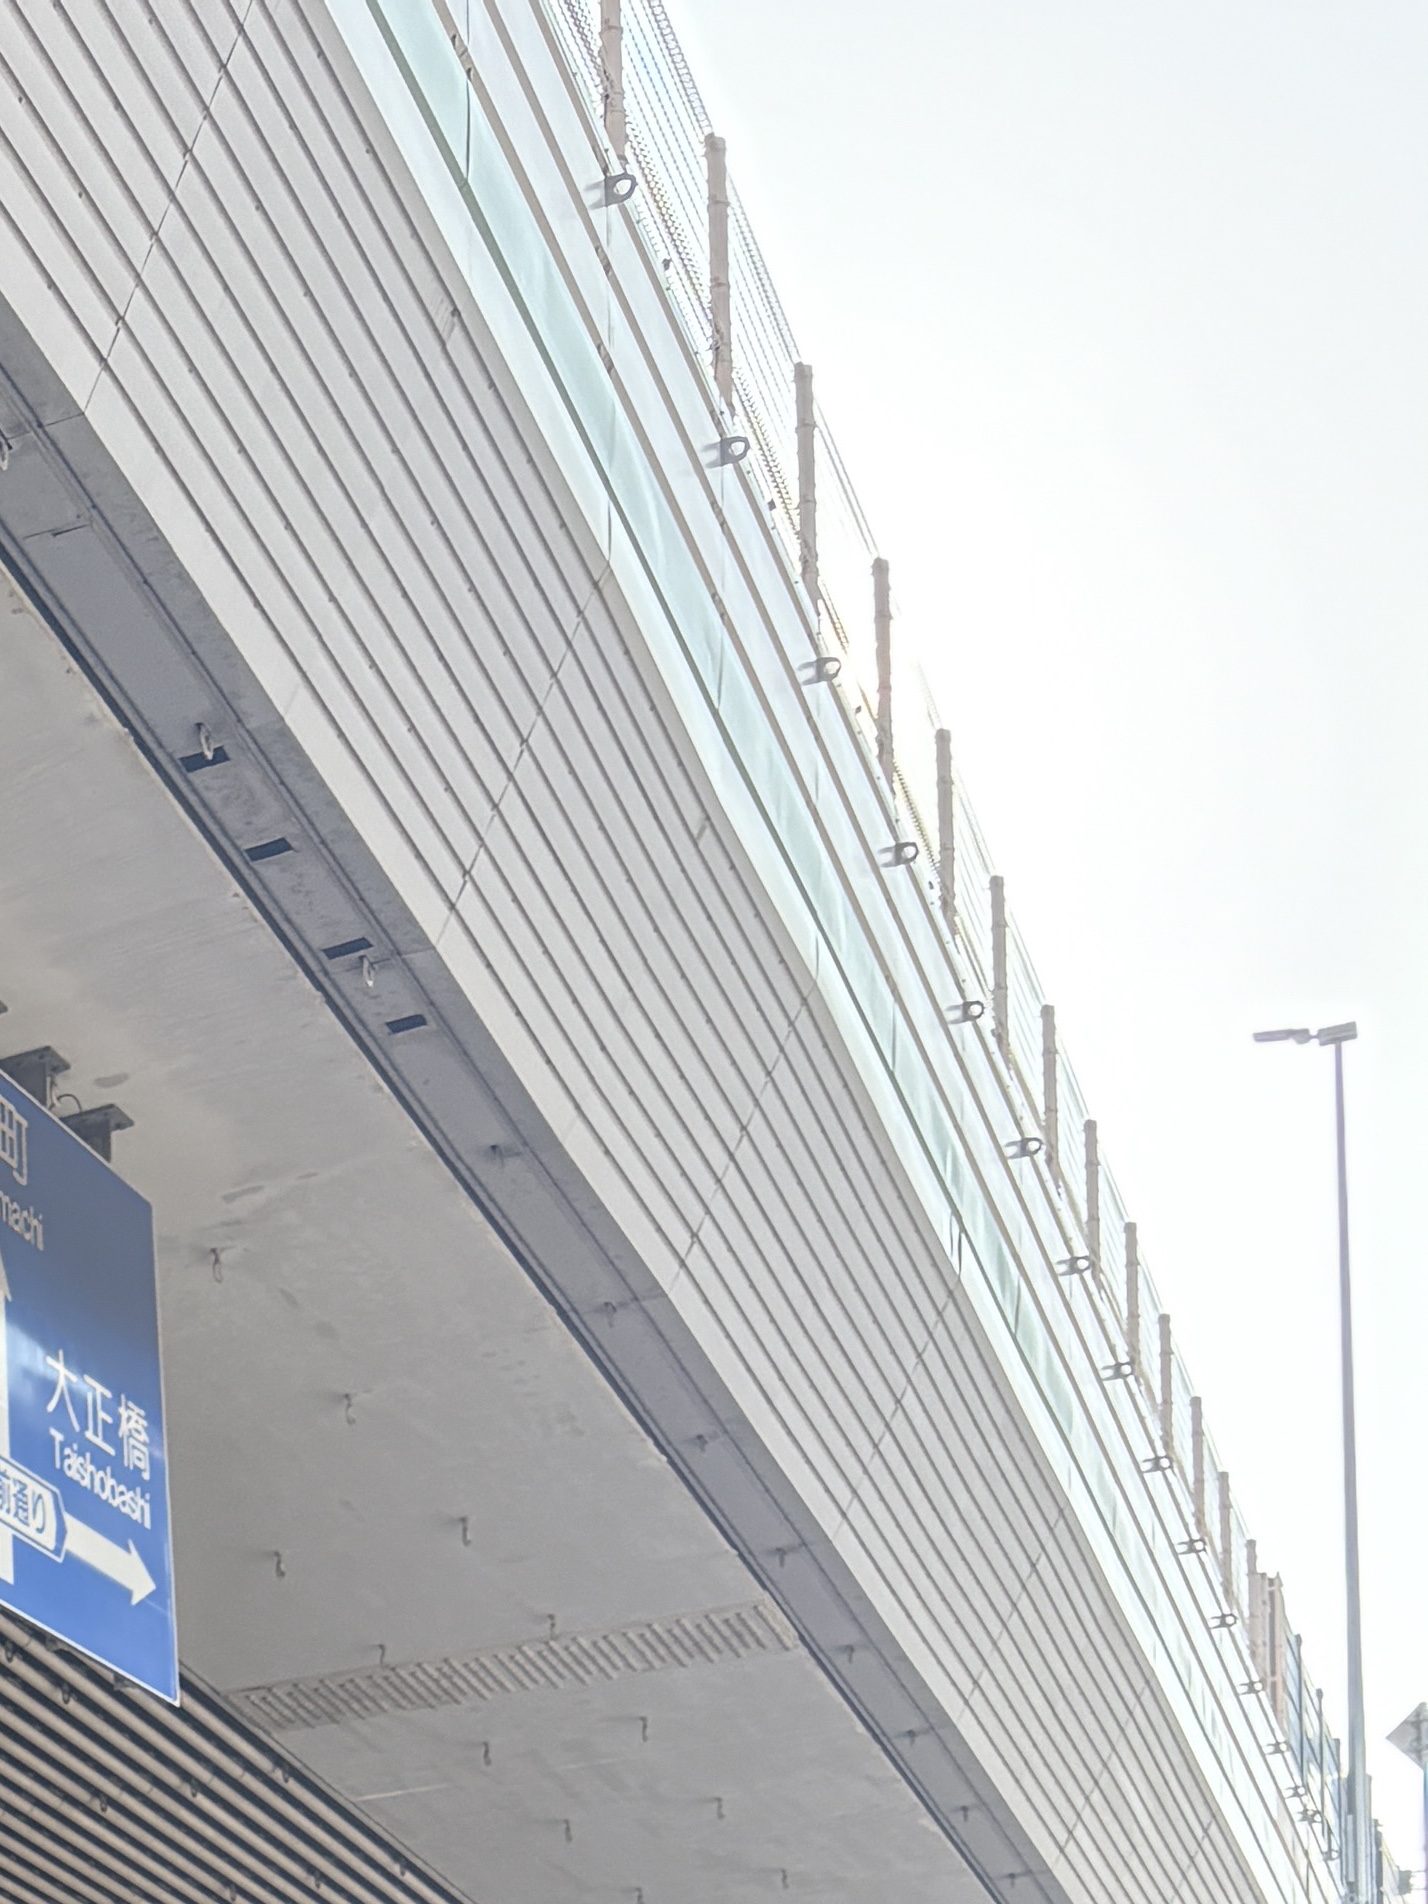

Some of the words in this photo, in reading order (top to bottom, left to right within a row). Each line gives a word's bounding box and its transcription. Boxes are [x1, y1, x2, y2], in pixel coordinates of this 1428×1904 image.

[46, 1350, 152, 1482] 大正橋
[50, 1428, 152, 1530] Taishobashi
